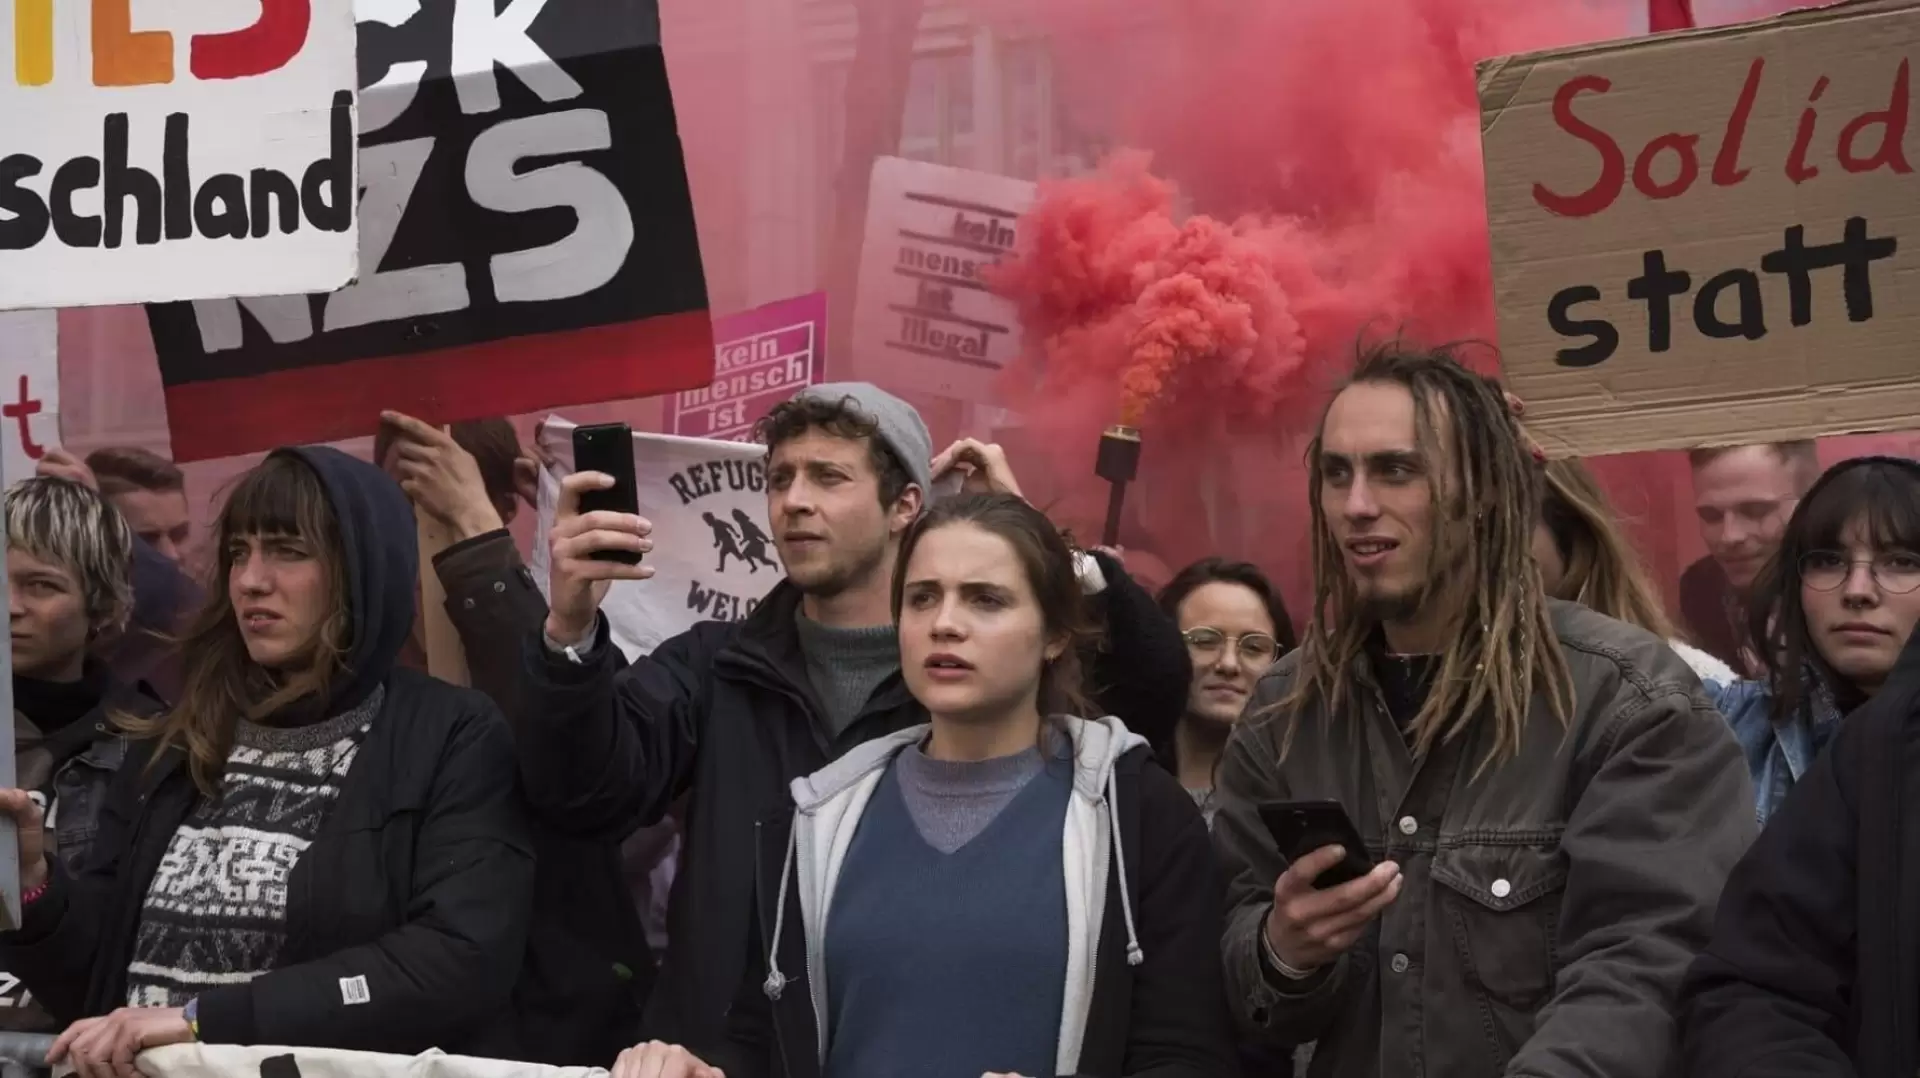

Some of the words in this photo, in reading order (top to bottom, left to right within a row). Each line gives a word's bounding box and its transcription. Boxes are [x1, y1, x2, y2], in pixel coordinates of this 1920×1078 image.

[1532, 56, 1915, 218] Solid
[0, 90, 354, 250] schland
[192, 108, 635, 354] ZS
[899, 246, 1002, 279] mens
[1547, 216, 1898, 367] statt
[715, 336, 779, 371] kein
[684, 356, 804, 408] mensch
[708, 400, 745, 430] ist
[668, 458, 769, 505] REFUG
